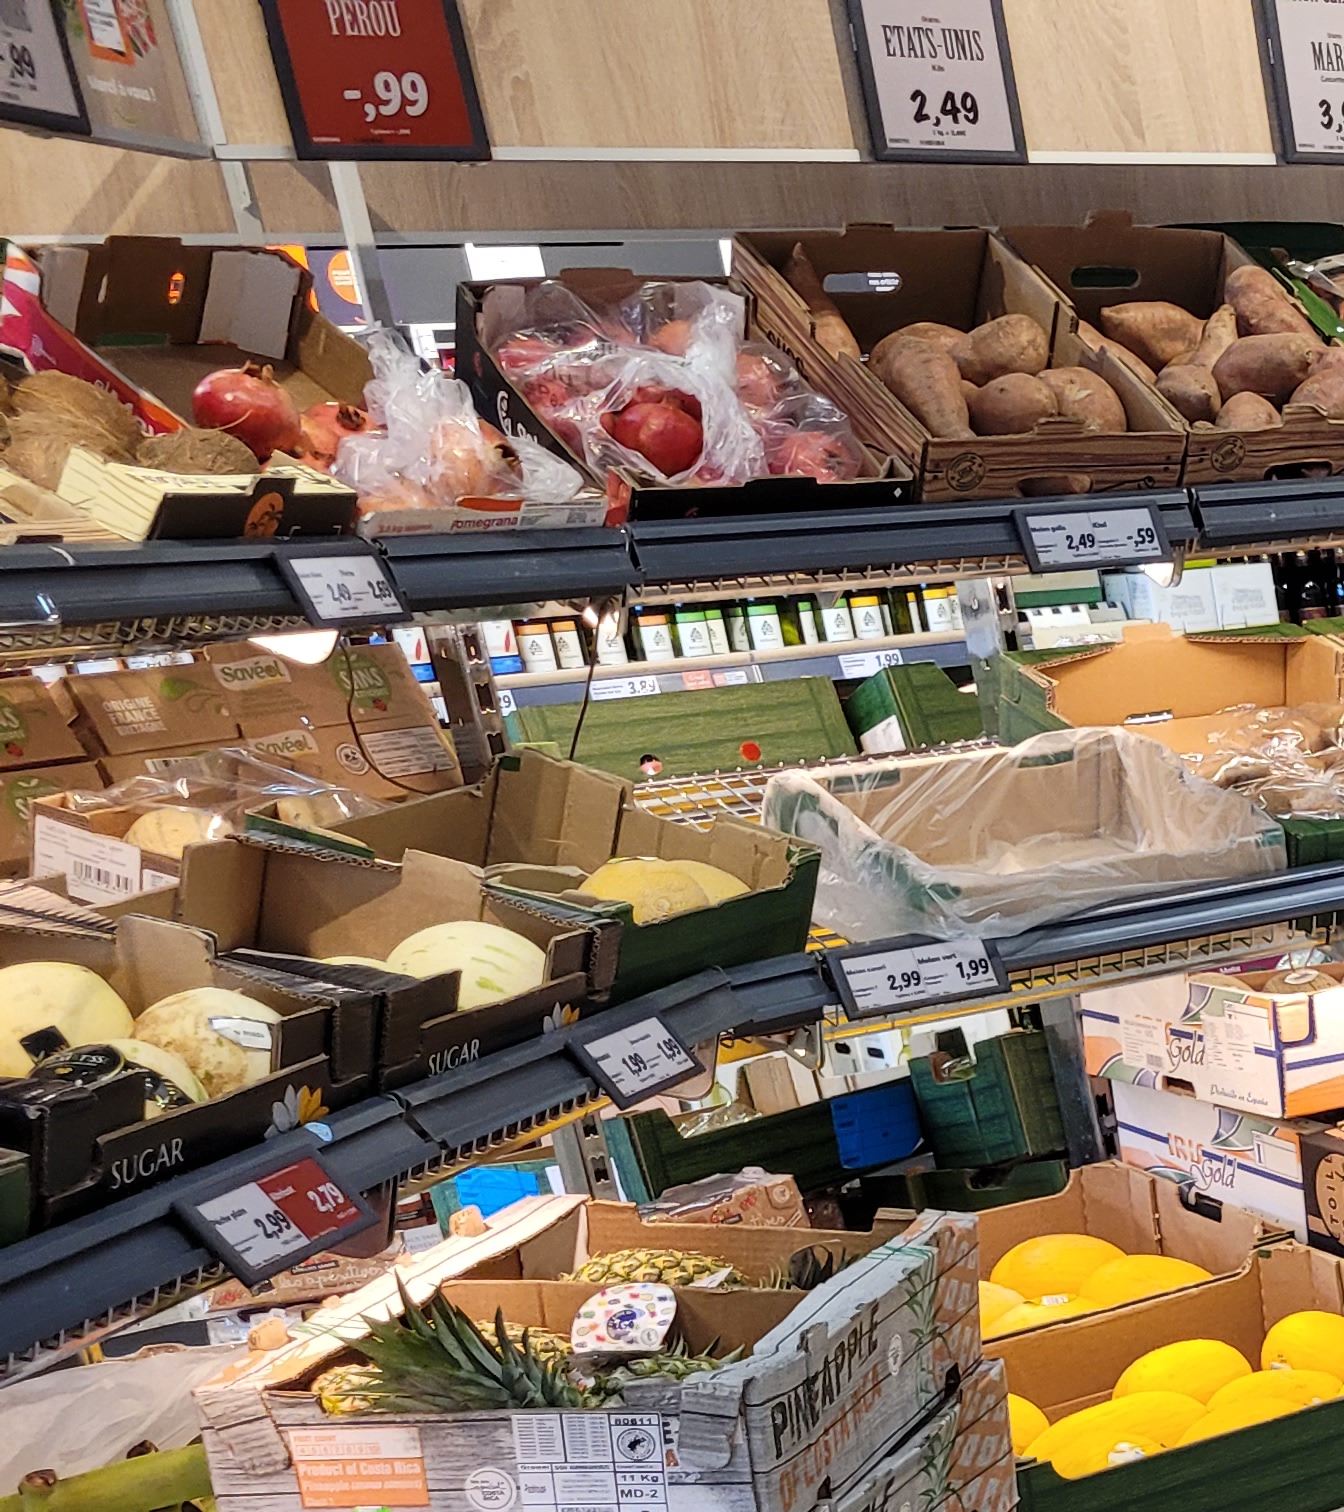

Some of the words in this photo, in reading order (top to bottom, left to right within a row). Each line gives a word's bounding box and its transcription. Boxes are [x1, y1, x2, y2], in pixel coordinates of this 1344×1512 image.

[325, 0, 402, 37] PEROU
[881, 24, 985, 62] ETATS-UNIS
[343, 71, 429, 122] -,99
[910, 89, 979, 127] 2,49
[1065, 533, 1096, 551] 2,49
[1125, 527, 1156, 548] -,59
[220, 656, 283, 682] Savéol
[875, 652, 900, 668] 1.99
[338, 667, 384, 690] SANS
[102, 696, 154, 712] ORIGINE
[108, 708, 161, 726] FRANCE
[254, 736, 314, 755] Savéol
[886, 970, 921, 992] 2,99
[954, 958, 989, 981] 1,99
[428, 1038, 480, 1076] SUGAR
[1168, 1030, 1207, 1073] Gold
[110, 1137, 185, 1190] SUGAR
[1189, 1154, 1237, 1191] Gold
[306, 1181, 345, 1214] 2,79
[253, 1208, 291, 1241] 2,99
[771, 1300, 879, 1460] PINEAPPLE
[300, 1463, 343, 1476] Product
[346, 1463, 357, 1475] of
[360, 1462, 393, 1475] Costa
[394, 1461, 421, 1475] Rica
[779, 1462, 801, 1512] OF
[803, 1409, 851, 1488] COSTA
[303, 1480, 350, 1493] Pineapple
[640, 1474, 659, 1483] Kg
[620, 1489, 659, 1499] MD-2
